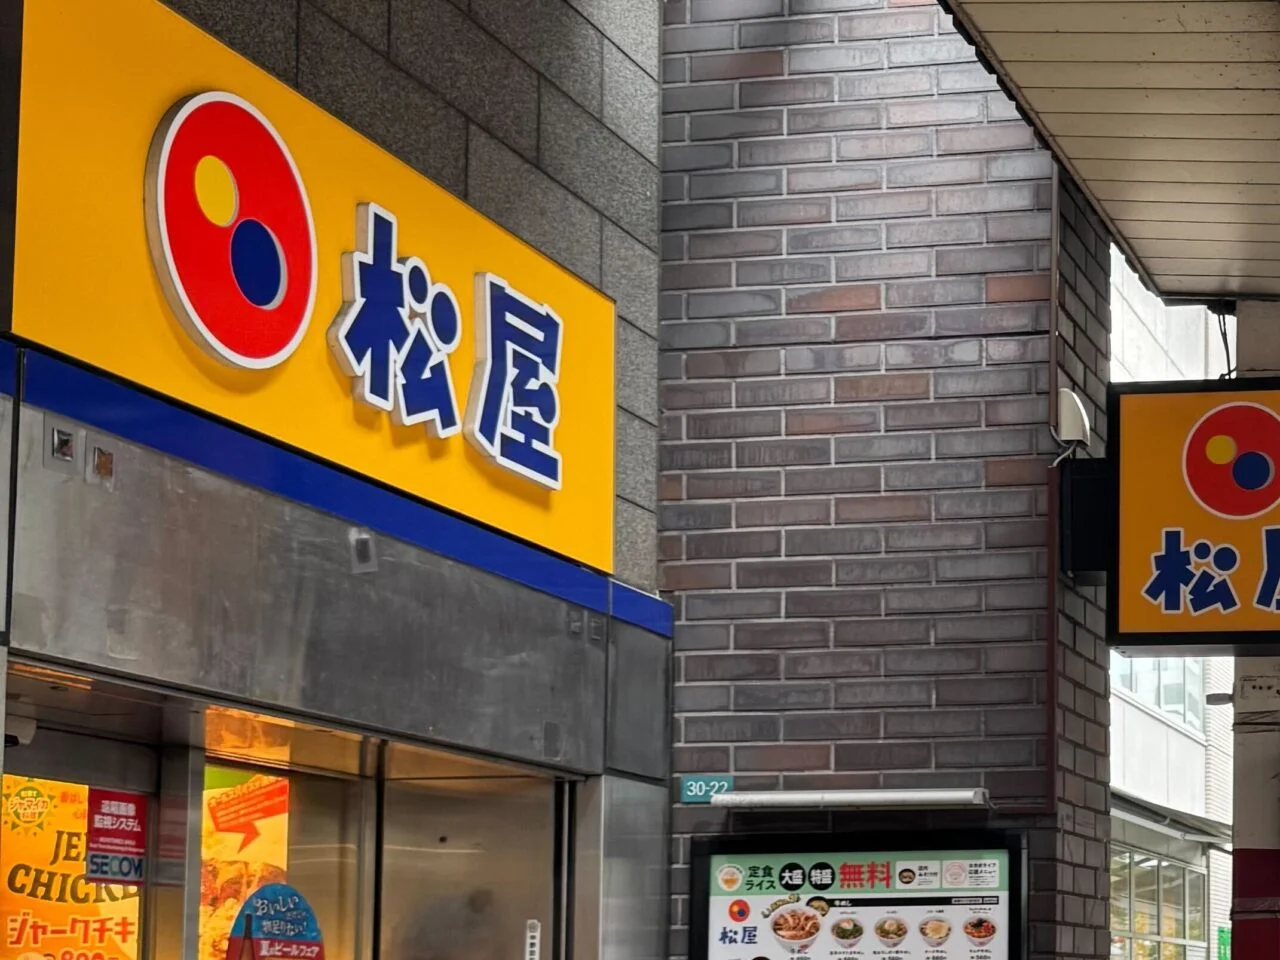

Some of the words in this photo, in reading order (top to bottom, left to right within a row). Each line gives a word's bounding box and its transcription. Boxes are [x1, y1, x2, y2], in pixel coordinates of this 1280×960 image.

[328, 202, 562, 490] 松屋
[686, 781, 728, 796] 30-22
[89, 854, 143, 878] SECOM
[748, 865, 774, 878] 定食
[781, 869, 803, 884] 大盛
[839, 862, 892, 888] 無料
[745, 879, 776, 891] ライス
[719, 926, 759, 945] 松屋
